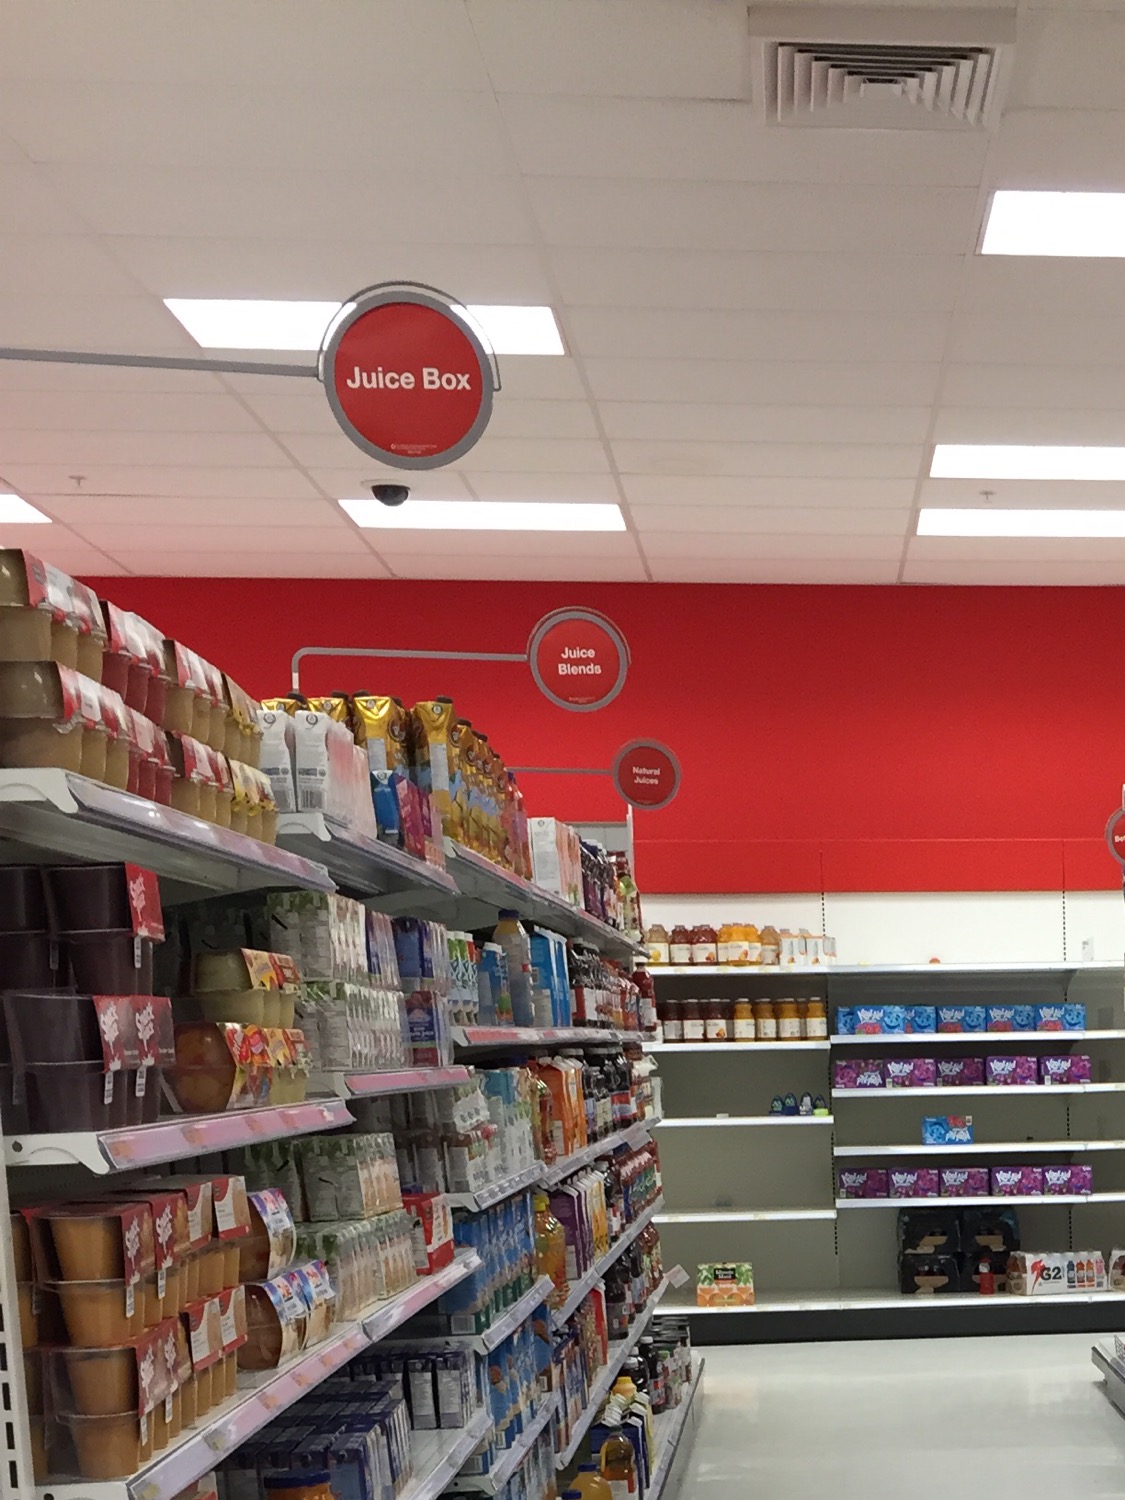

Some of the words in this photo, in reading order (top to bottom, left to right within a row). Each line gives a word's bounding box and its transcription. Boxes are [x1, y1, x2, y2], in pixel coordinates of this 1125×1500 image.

[346, 366, 415, 389] Juice
[422, 367, 471, 390] Box
[561, 647, 595, 659] Juice
[558, 662, 602, 675] Blends
[632, 766, 661, 776] Natural
[634, 776, 659, 785] Juices
[1041, 1266, 1062, 1281] G2
